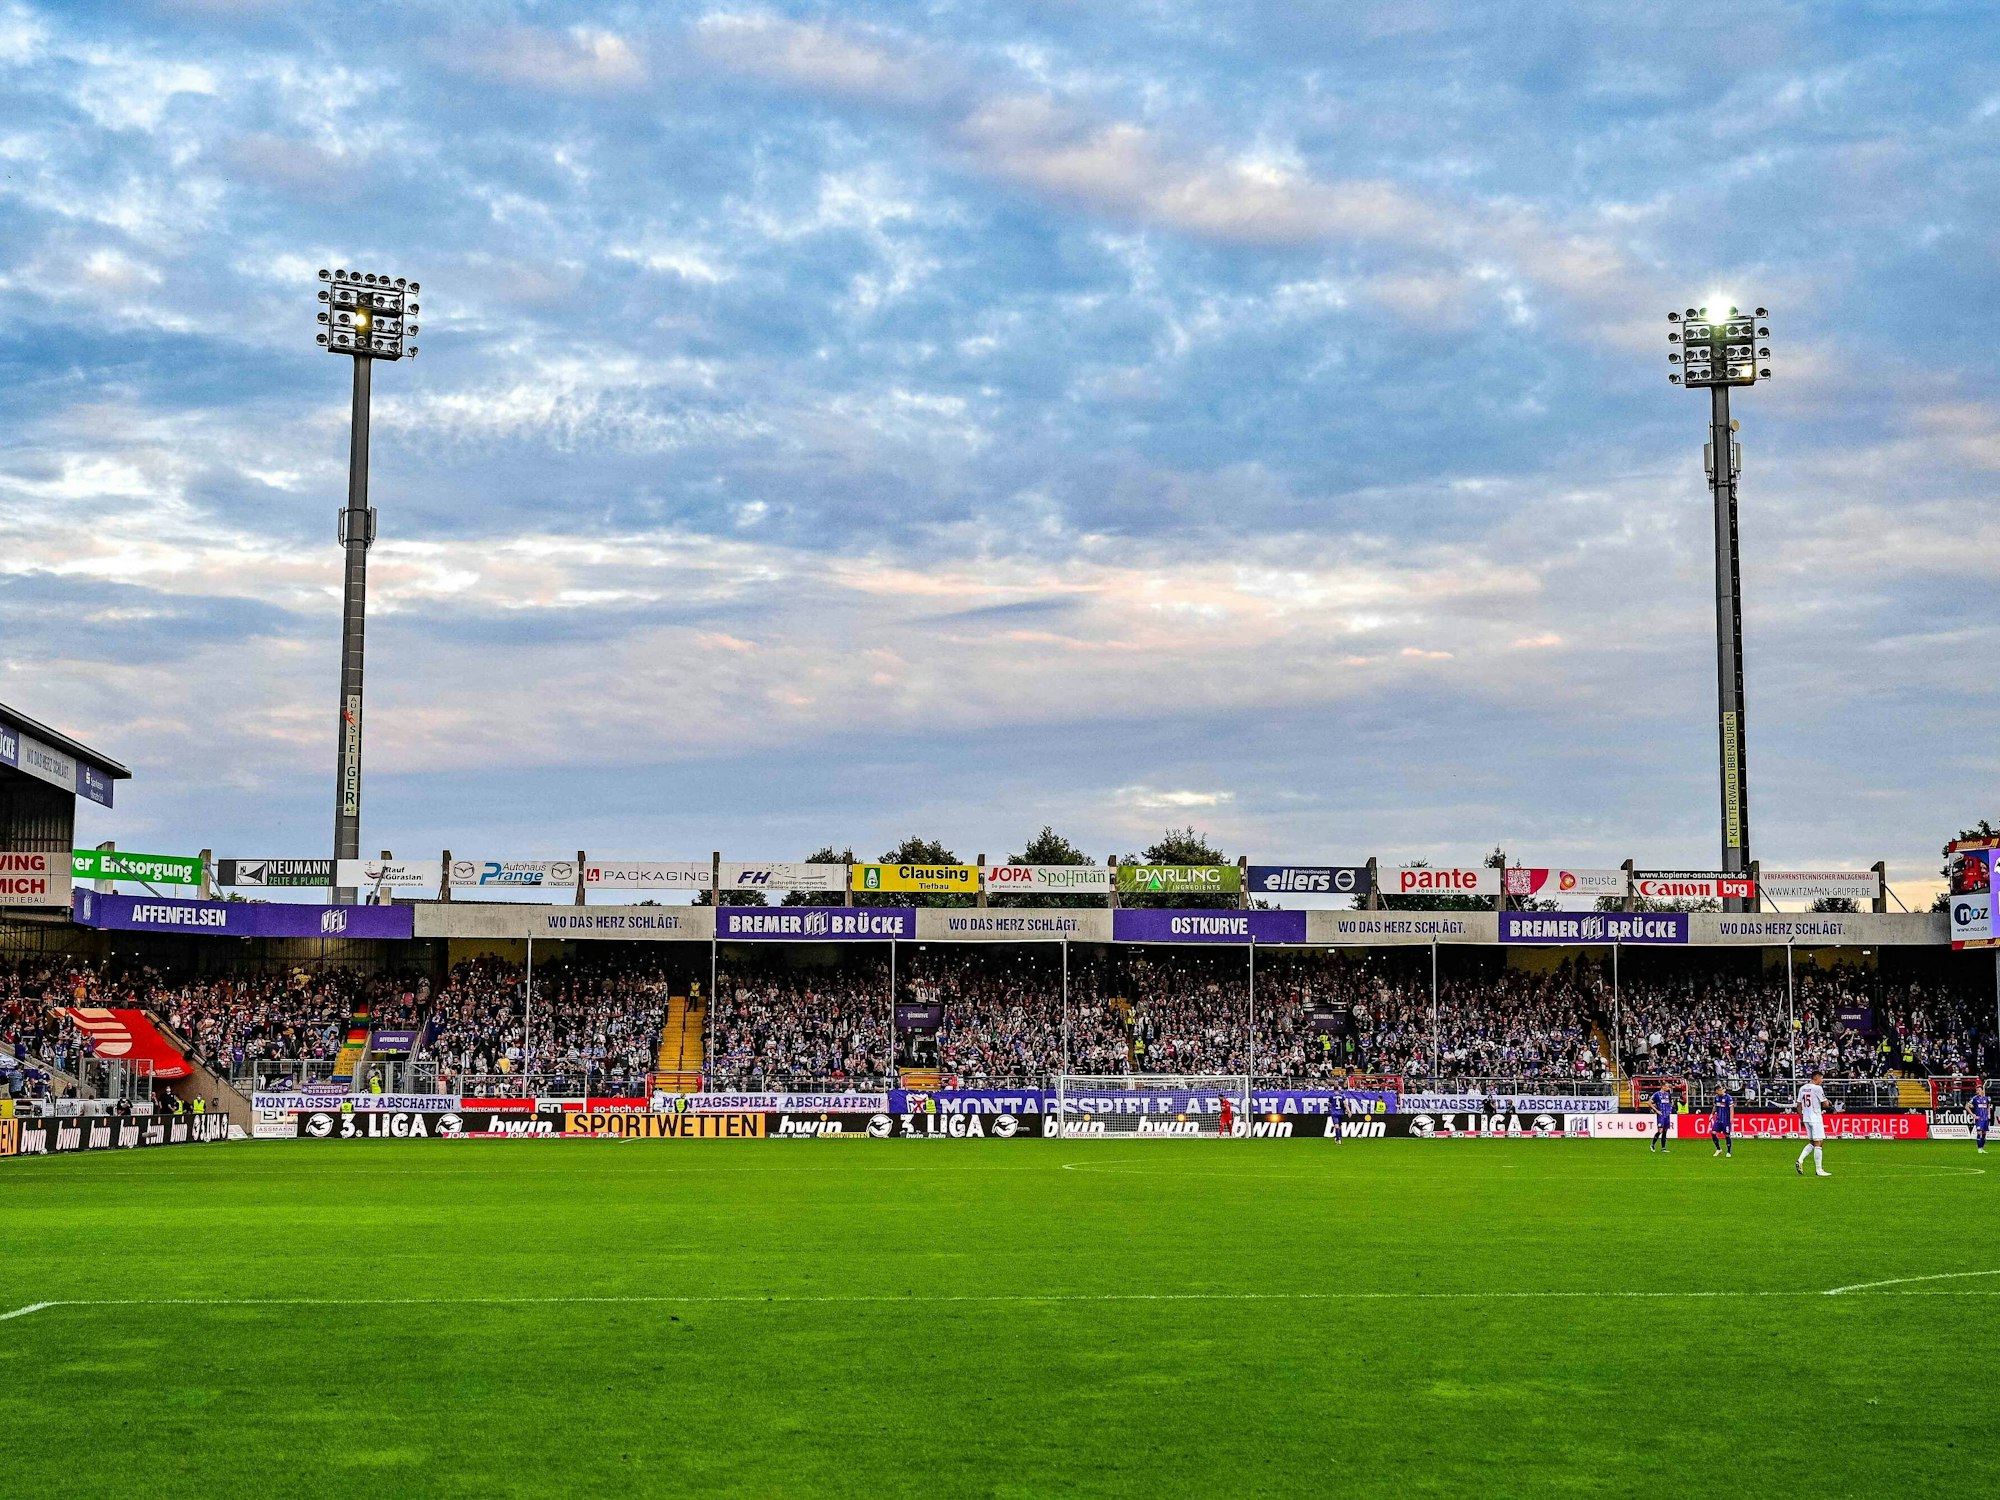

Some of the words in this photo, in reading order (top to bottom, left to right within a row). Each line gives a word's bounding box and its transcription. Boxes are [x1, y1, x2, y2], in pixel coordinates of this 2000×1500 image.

[1725, 714, 1735, 771] IBBENBÜREN
[1728, 773, 1738, 837] KLETTERWALD
[101, 856, 192, 882] Entsorgung
[269, 861, 330, 874] NEUMANN
[480, 863, 543, 885] Prange
[502, 863, 546, 871] Autohaus
[899, 866, 968, 882] Clausing
[1136, 869, 1220, 882] DARLING
[269, 877, 290, 885] ZELTE
[293, 877, 298, 885] &
[301, 877, 330, 885] PLANEN
[604, 871, 709, 881] PACKAGING
[738, 871, 771, 884] FH
[1264, 869, 1330, 891] ellers
[1401, 869, 1477, 893] pante
[1581, 875, 1617, 885] neusta
[1640, 881, 1710, 896] Canon
[1723, 881, 1748, 897] brg
[1768, 886, 1870, 896] WWW.KITZMANN-GRUPPE.DE
[132, 905, 227, 926] AFFENFELSEN
[548, 916, 566, 929] WO
[570, 916, 592, 929] DAS
[596, 916, 624, 929] HERZ
[628, 914, 682, 929] SCHLÄGT.
[729, 915, 801, 933] BREMER
[832, 912, 903, 933] BRÜCKE
[949, 918, 967, 931] WO
[970, 918, 993, 931] DAS
[995, 918, 1024, 931] HERZ
[1028, 916, 1080, 931] SCHLÄGT.
[1171, 918, 1248, 934] OSTKURVE
[1338, 921, 1356, 933] WO
[1359, 921, 1381, 933] DAS
[1383, 921, 1411, 933] HERZ
[1414, 919, 1466, 933] SCHLÄGT.
[1509, 920, 1578, 937] BREMER
[1608, 917, 1676, 937] BRÜCKE
[1720, 923, 1737, 935] WO
[1741, 923, 1762, 935] DAS
[1765, 923, 1791, 935] HERZ
[1795, 921, 1846, 935] SCHLÄGT.
[376, 1097, 454, 1109] ABSCHAFFEN!
[594, 1105, 646, 1113] so-tech.eu
[785, 1097, 881, 1108] ABSCHAFFEN!
[940, 1098, 1172, 1113] MONTAGSSPIELE
[1186, 1098, 1375, 1113] ABSCHAFFN!
[1402, 1099, 1512, 1109] MONTAGSSPLE
[1518, 1099, 1610, 1111] ABSCHAFFEN!
[340, 1113, 363, 1138] 3.
[369, 1113, 428, 1137] LIGA
[488, 1114, 553, 1133] bwin
[779, 1114, 842, 1135] bwin
[927, 1114, 985, 1137] LIGA
[1044, 1114, 1105, 1137] bwin
[1138, 1114, 1200, 1133] bwin
[1324, 1114, 1386, 1137] bwin
[1925, 1110, 1976, 1124] Herforde
[56, 1118, 80, 1150] bwin
[88, 1118, 111, 1148] bwin
[118, 1117, 139, 1146] bwin
[170, 1116, 187, 1142] bwin
[574, 1115, 757, 1137] SPORTWETTEN
[1695, 1118, 1909, 1135] GAELSTAPL-VERTRIEB
[20, 1119, 46, 1152] bwin
